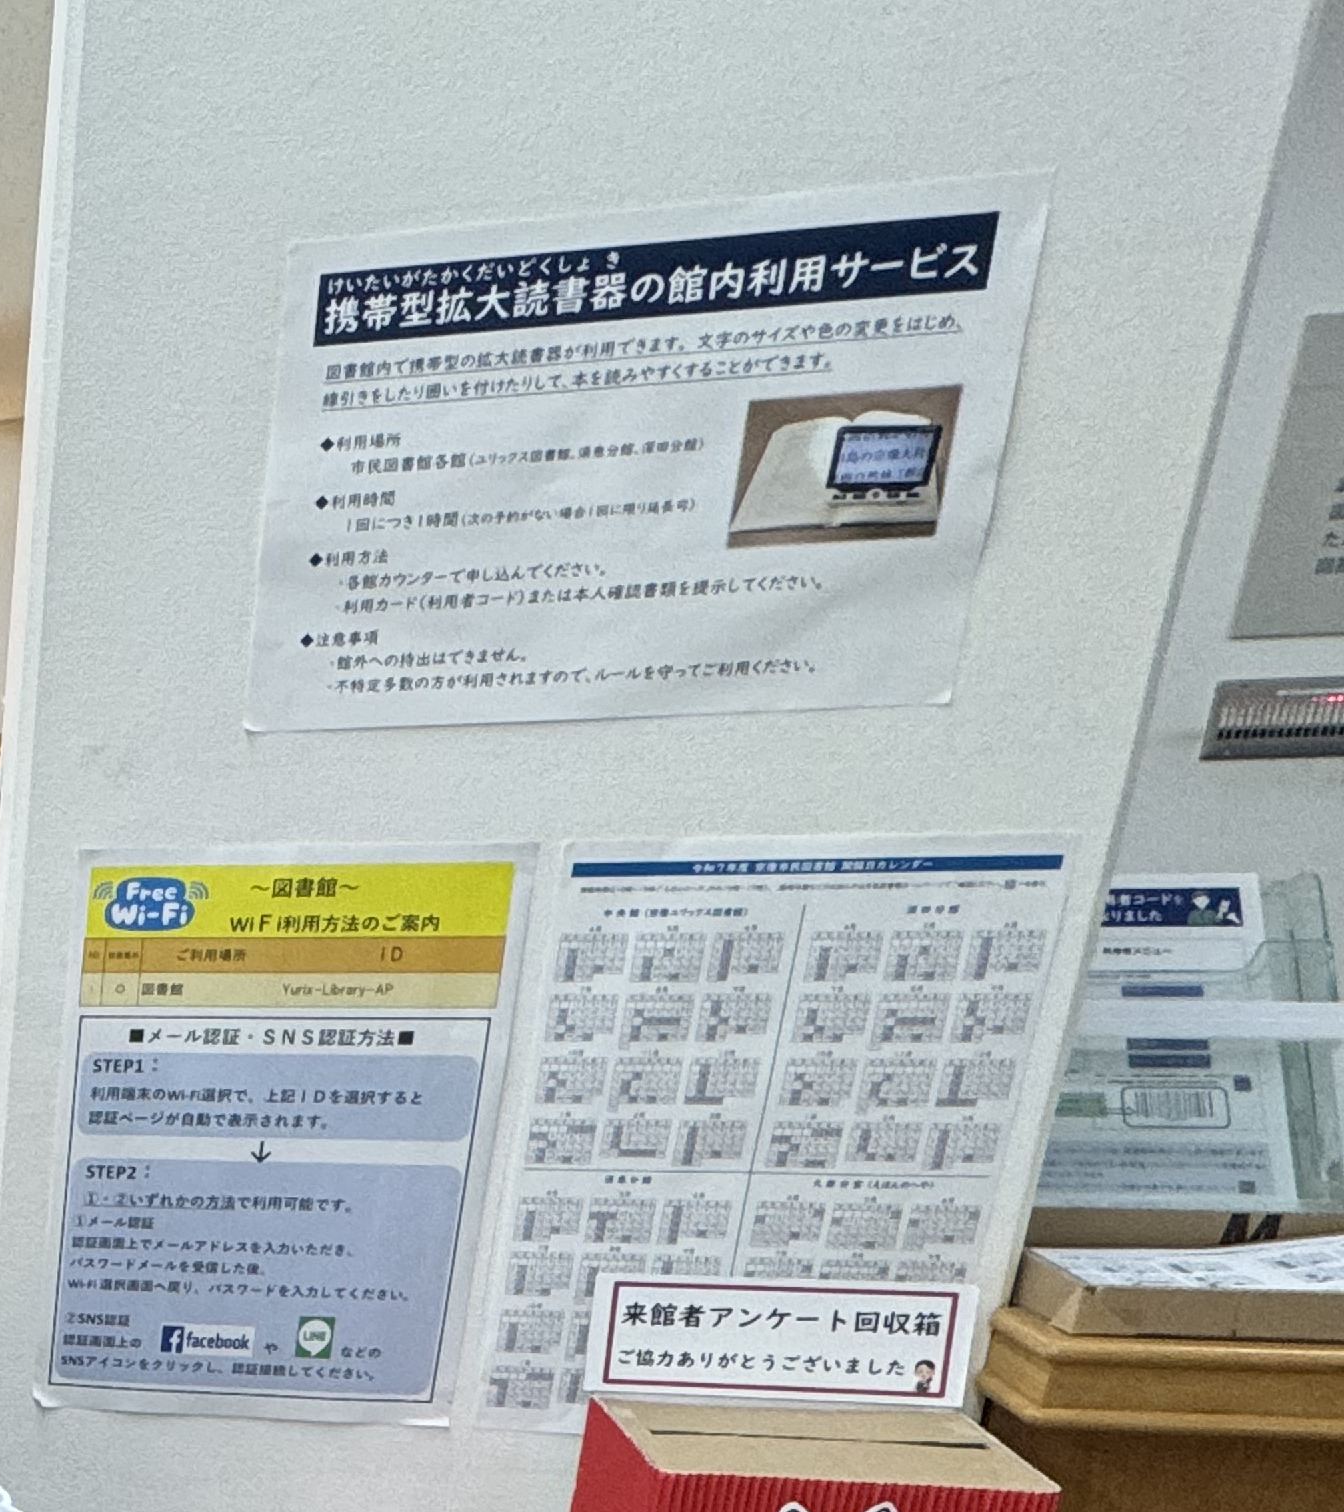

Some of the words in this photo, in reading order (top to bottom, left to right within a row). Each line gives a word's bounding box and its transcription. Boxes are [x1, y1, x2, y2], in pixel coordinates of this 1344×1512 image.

[324, 243, 981, 335] 携帯型拡大読書器の館内利用サービス
[325, 549, 389, 568] 利用方法
[315, 629, 379, 648] 注意事項
[125, 881, 178, 901] Free
[110, 902, 189, 927] Wi-Fi
[141, 982, 184, 996] 図書館
[621, 1301, 943, 1337] 来館者アンケート回収箱
[185, 1331, 251, 1351] facebook
[617, 1347, 906, 1377] ご協力ありがとうございました
